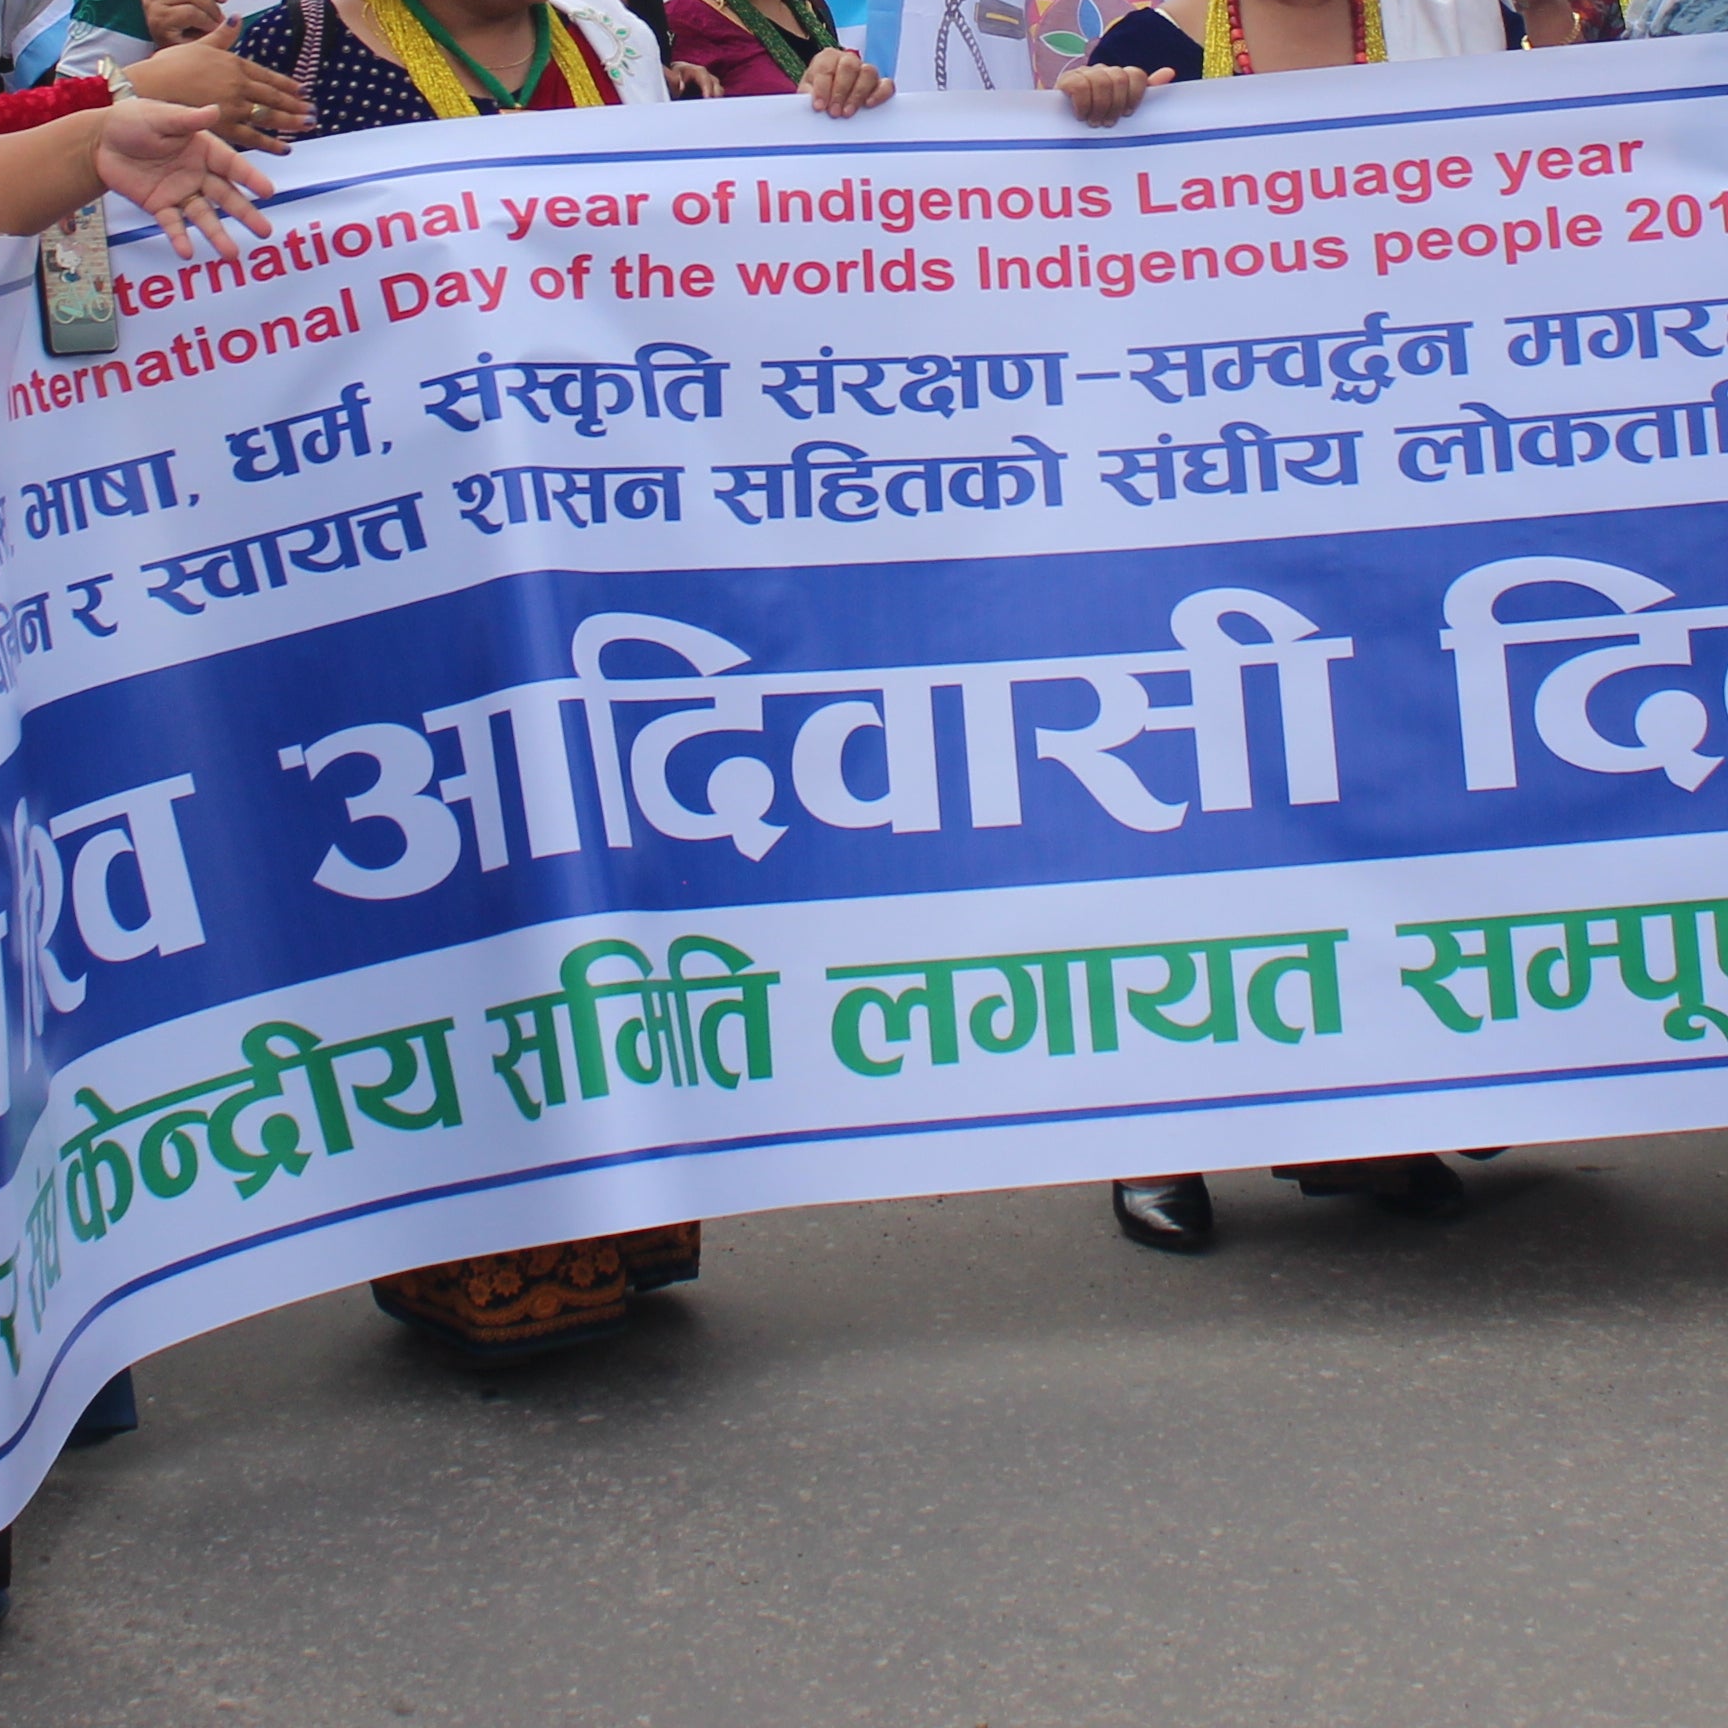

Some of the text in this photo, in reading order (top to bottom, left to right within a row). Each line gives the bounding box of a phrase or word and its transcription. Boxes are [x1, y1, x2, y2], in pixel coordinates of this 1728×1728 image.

[380, 266, 508, 324] Day
[529, 255, 591, 300] of
[611, 252, 715, 299] the
[737, 248, 956, 297] worlds
[977, 233, 1349, 298] Indigenous
[1373, 206, 1604, 275] people
[501, 192, 650, 242] year
[673, 180, 736, 225] of
[757, 177, 1113, 233] Indigenous
[1137, 153, 1474, 215] Language
[1495, 137, 1644, 195] year
[420, 341, 731, 438] संस्कृति
[66, 573, 118, 638] र
[140, 491, 430, 616] स्वायत्त
[452, 464, 684, 534] शासन
[710, 433, 1068, 526] सहितको
[1098, 420, 1364, 509] संघीय
[277, 586, 1355, 902] आदिवासी
[59, 1020, 464, 1244] केन्द्रीय
[485, 934, 782, 1122] समिति
[824, 927, 1350, 1078] लगायत
